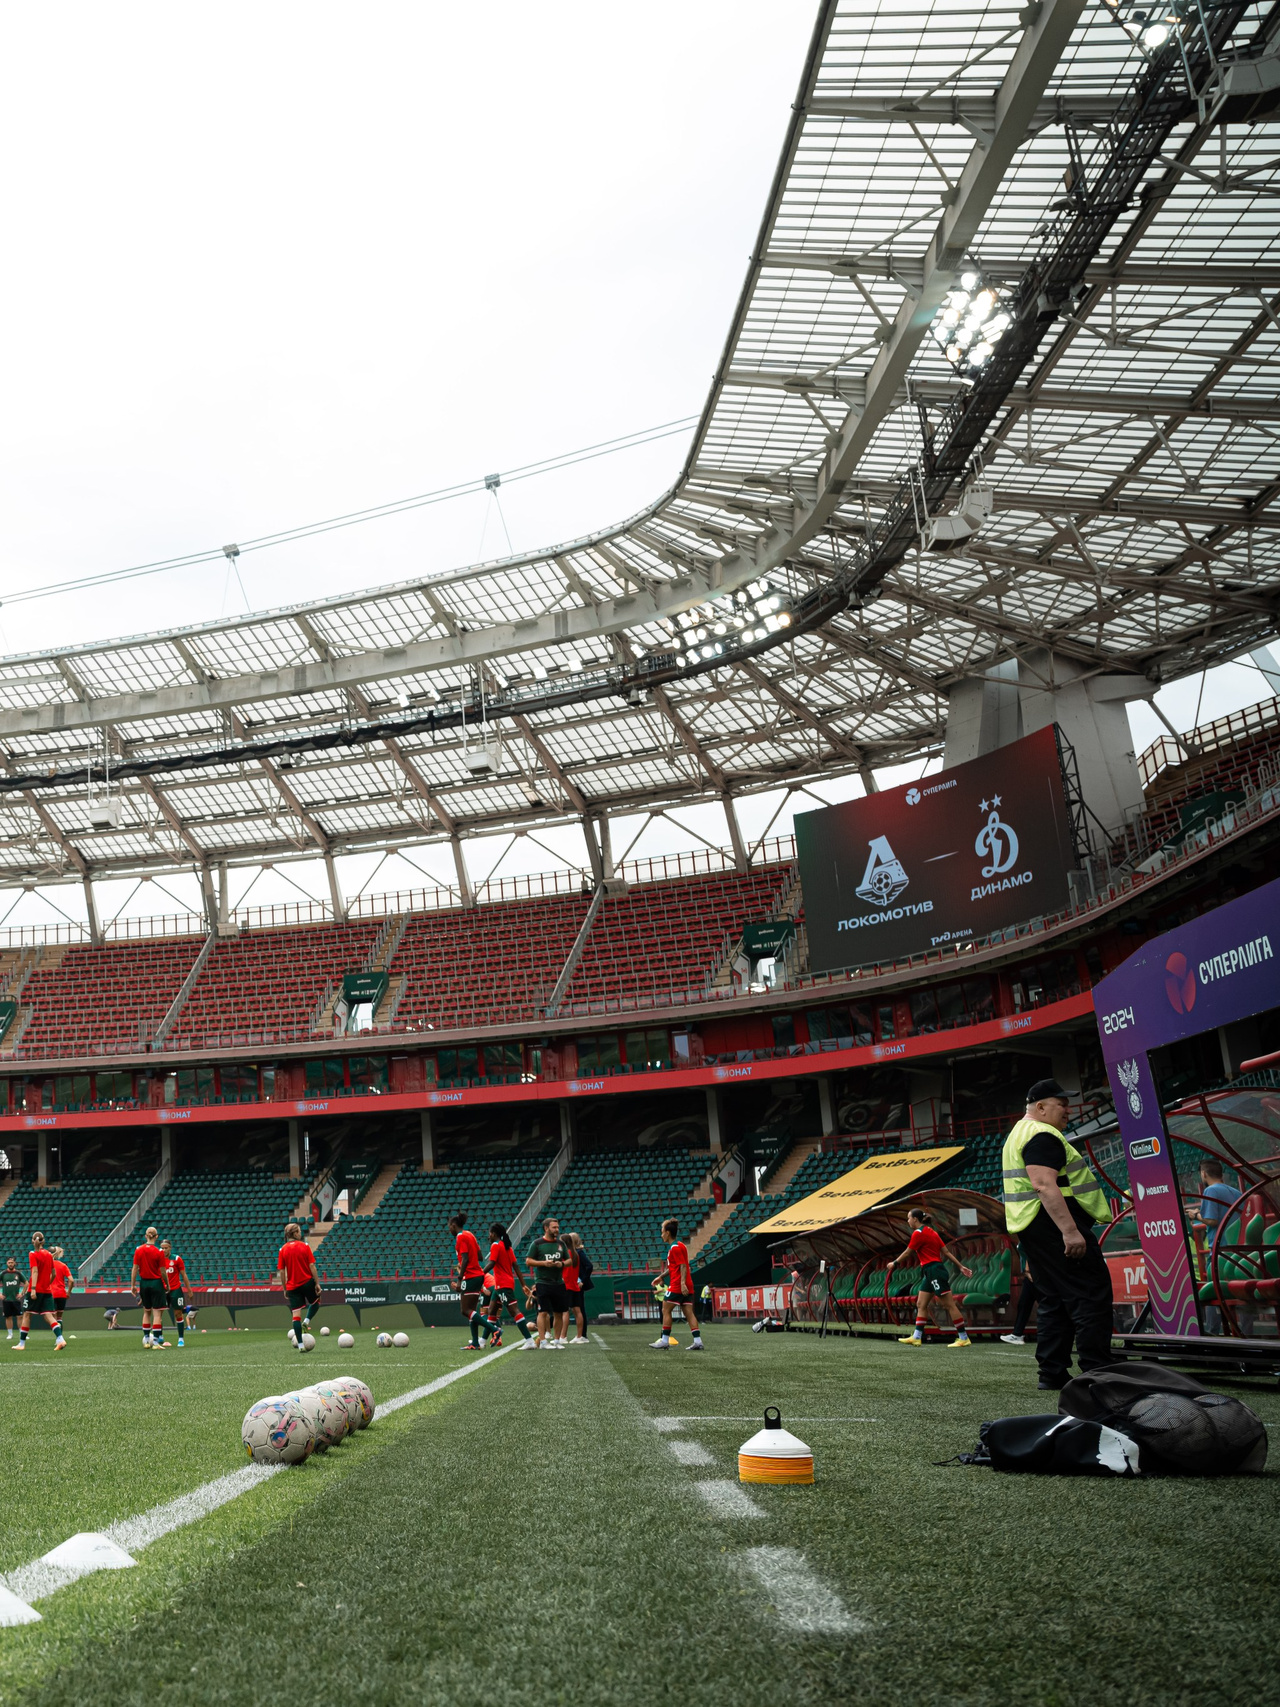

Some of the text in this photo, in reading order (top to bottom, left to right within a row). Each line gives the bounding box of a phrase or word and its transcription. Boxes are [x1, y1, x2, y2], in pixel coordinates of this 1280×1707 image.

[970, 871, 1033, 901] ДИНАМО
[837, 900, 934, 931] ЛОКОМОТИВ
[951, 928, 973, 940] АРЕНА
[1199, 935, 1273, 985] СУПЕРЛИГА
[1102, 1006, 1135, 1035] 2024
[1131, 1144, 1153, 1156] Winline
[863, 1155, 942, 1170] BetBoom
[817, 1186, 896, 1199] BetBoom
[1146, 1184, 1169, 1196] НОВАТЭК
[770, 1215, 848, 1228] BetBoom
[405, 1293, 462, 1302] СТАНЬ ЛЕГЕН
